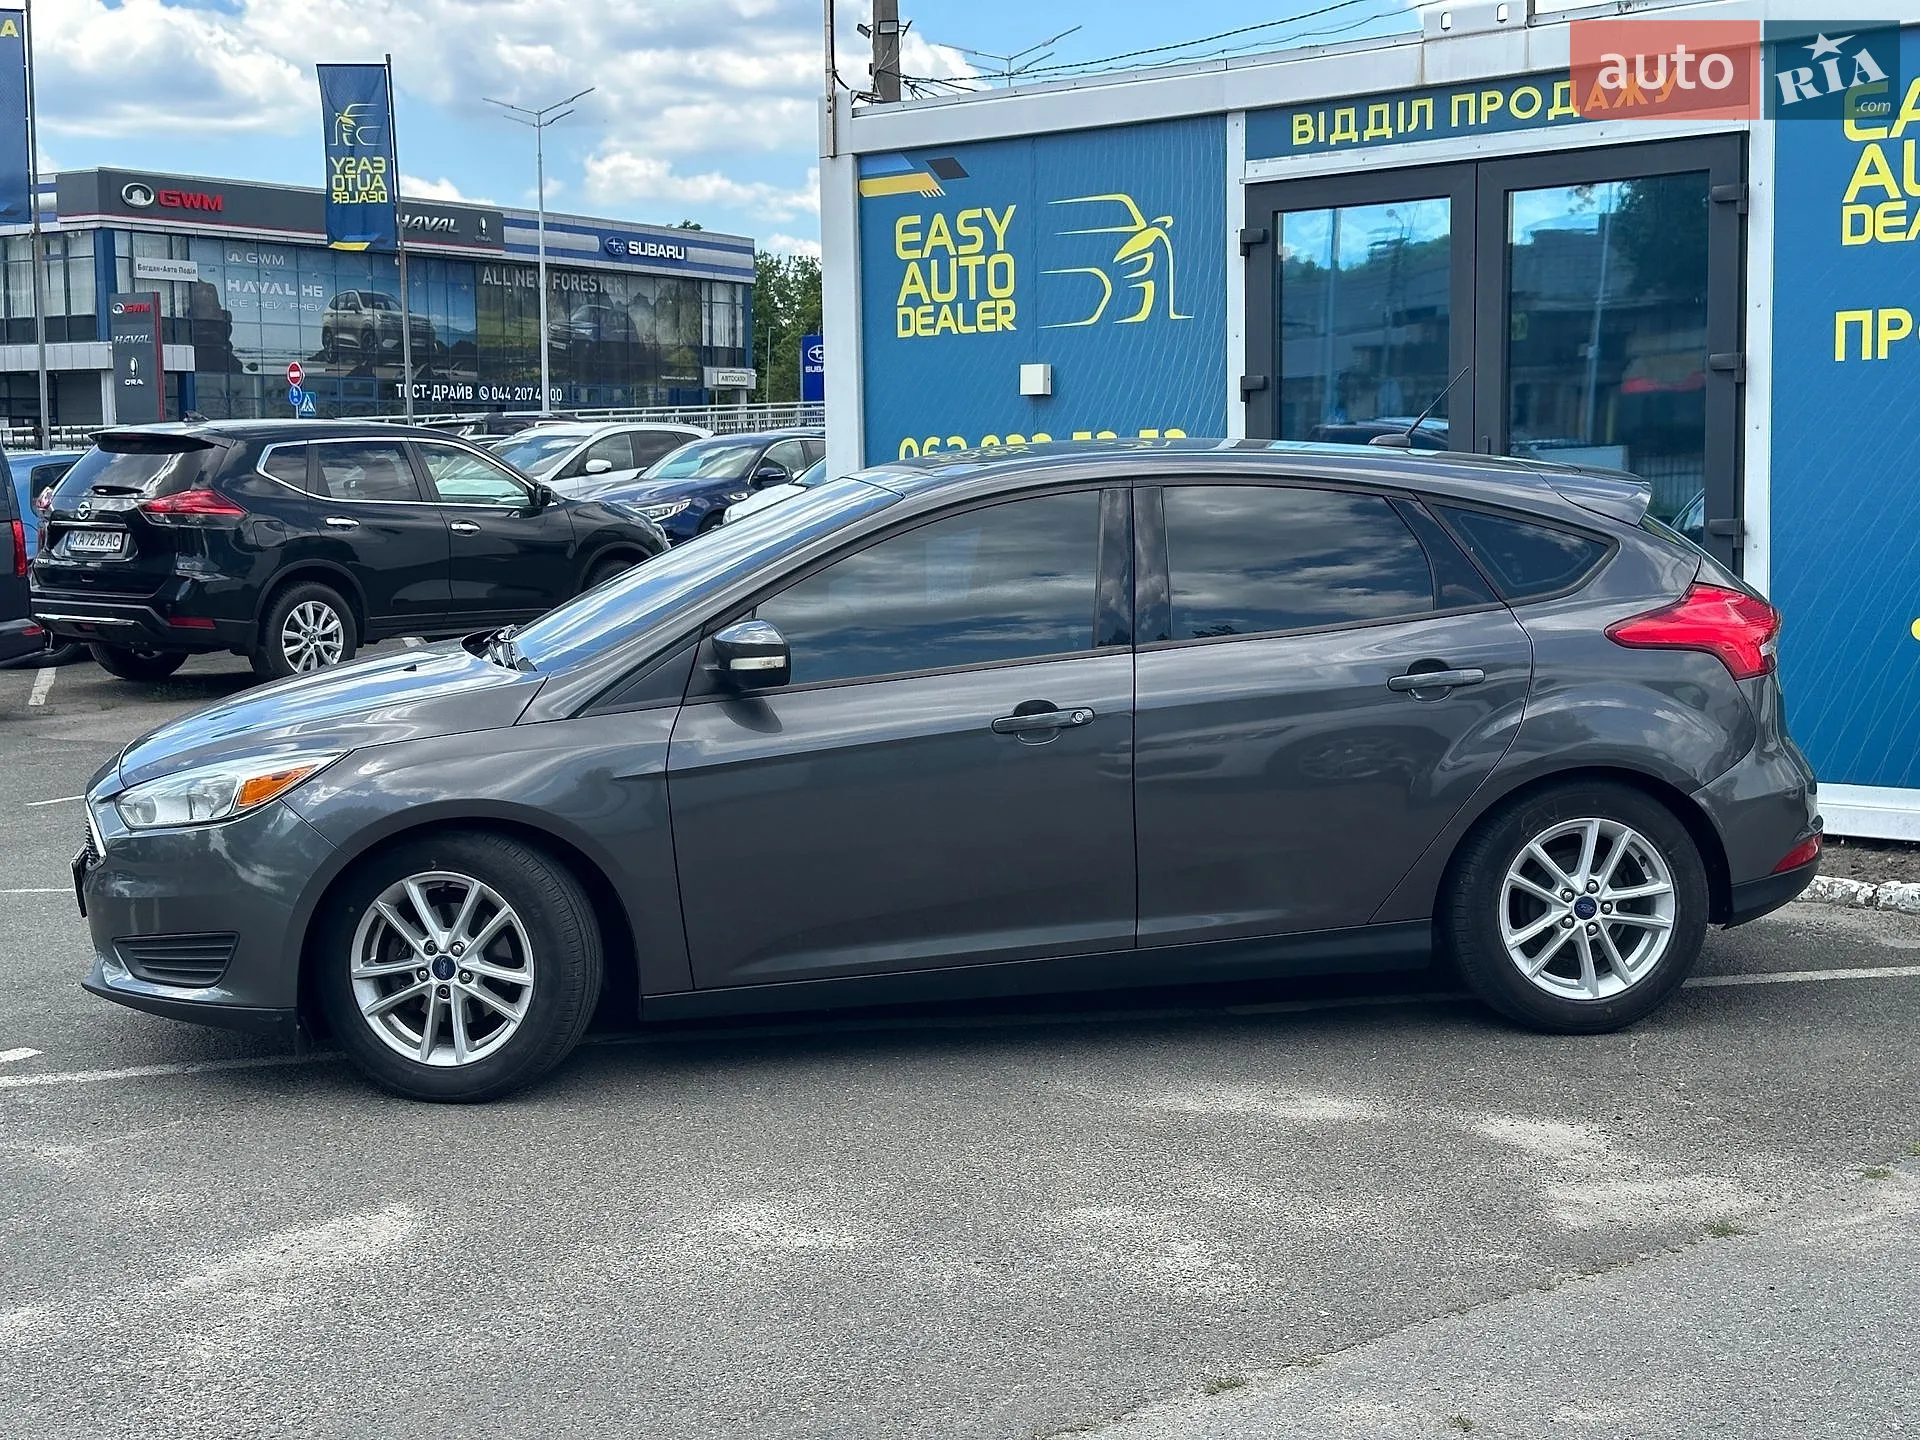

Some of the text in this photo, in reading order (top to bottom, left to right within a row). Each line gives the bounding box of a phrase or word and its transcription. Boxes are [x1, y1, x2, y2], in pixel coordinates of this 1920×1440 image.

[1292, 97, 1433, 146] ВІДДІЛ
[158, 189, 224, 212] GWM
[396, 213, 460, 233] HAVAL
[895, 204, 1017, 261] EASY
[246, 252, 285, 266] GWM
[628, 240, 685, 260] SUBARU
[482, 266, 511, 286] ALL
[897, 253, 1016, 306] AUTO
[227, 279, 324, 298] HAVAL H6
[896, 300, 1017, 339] DEALER
[114, 334, 152, 344] HAVAL
[491, 386, 511, 401] 044
